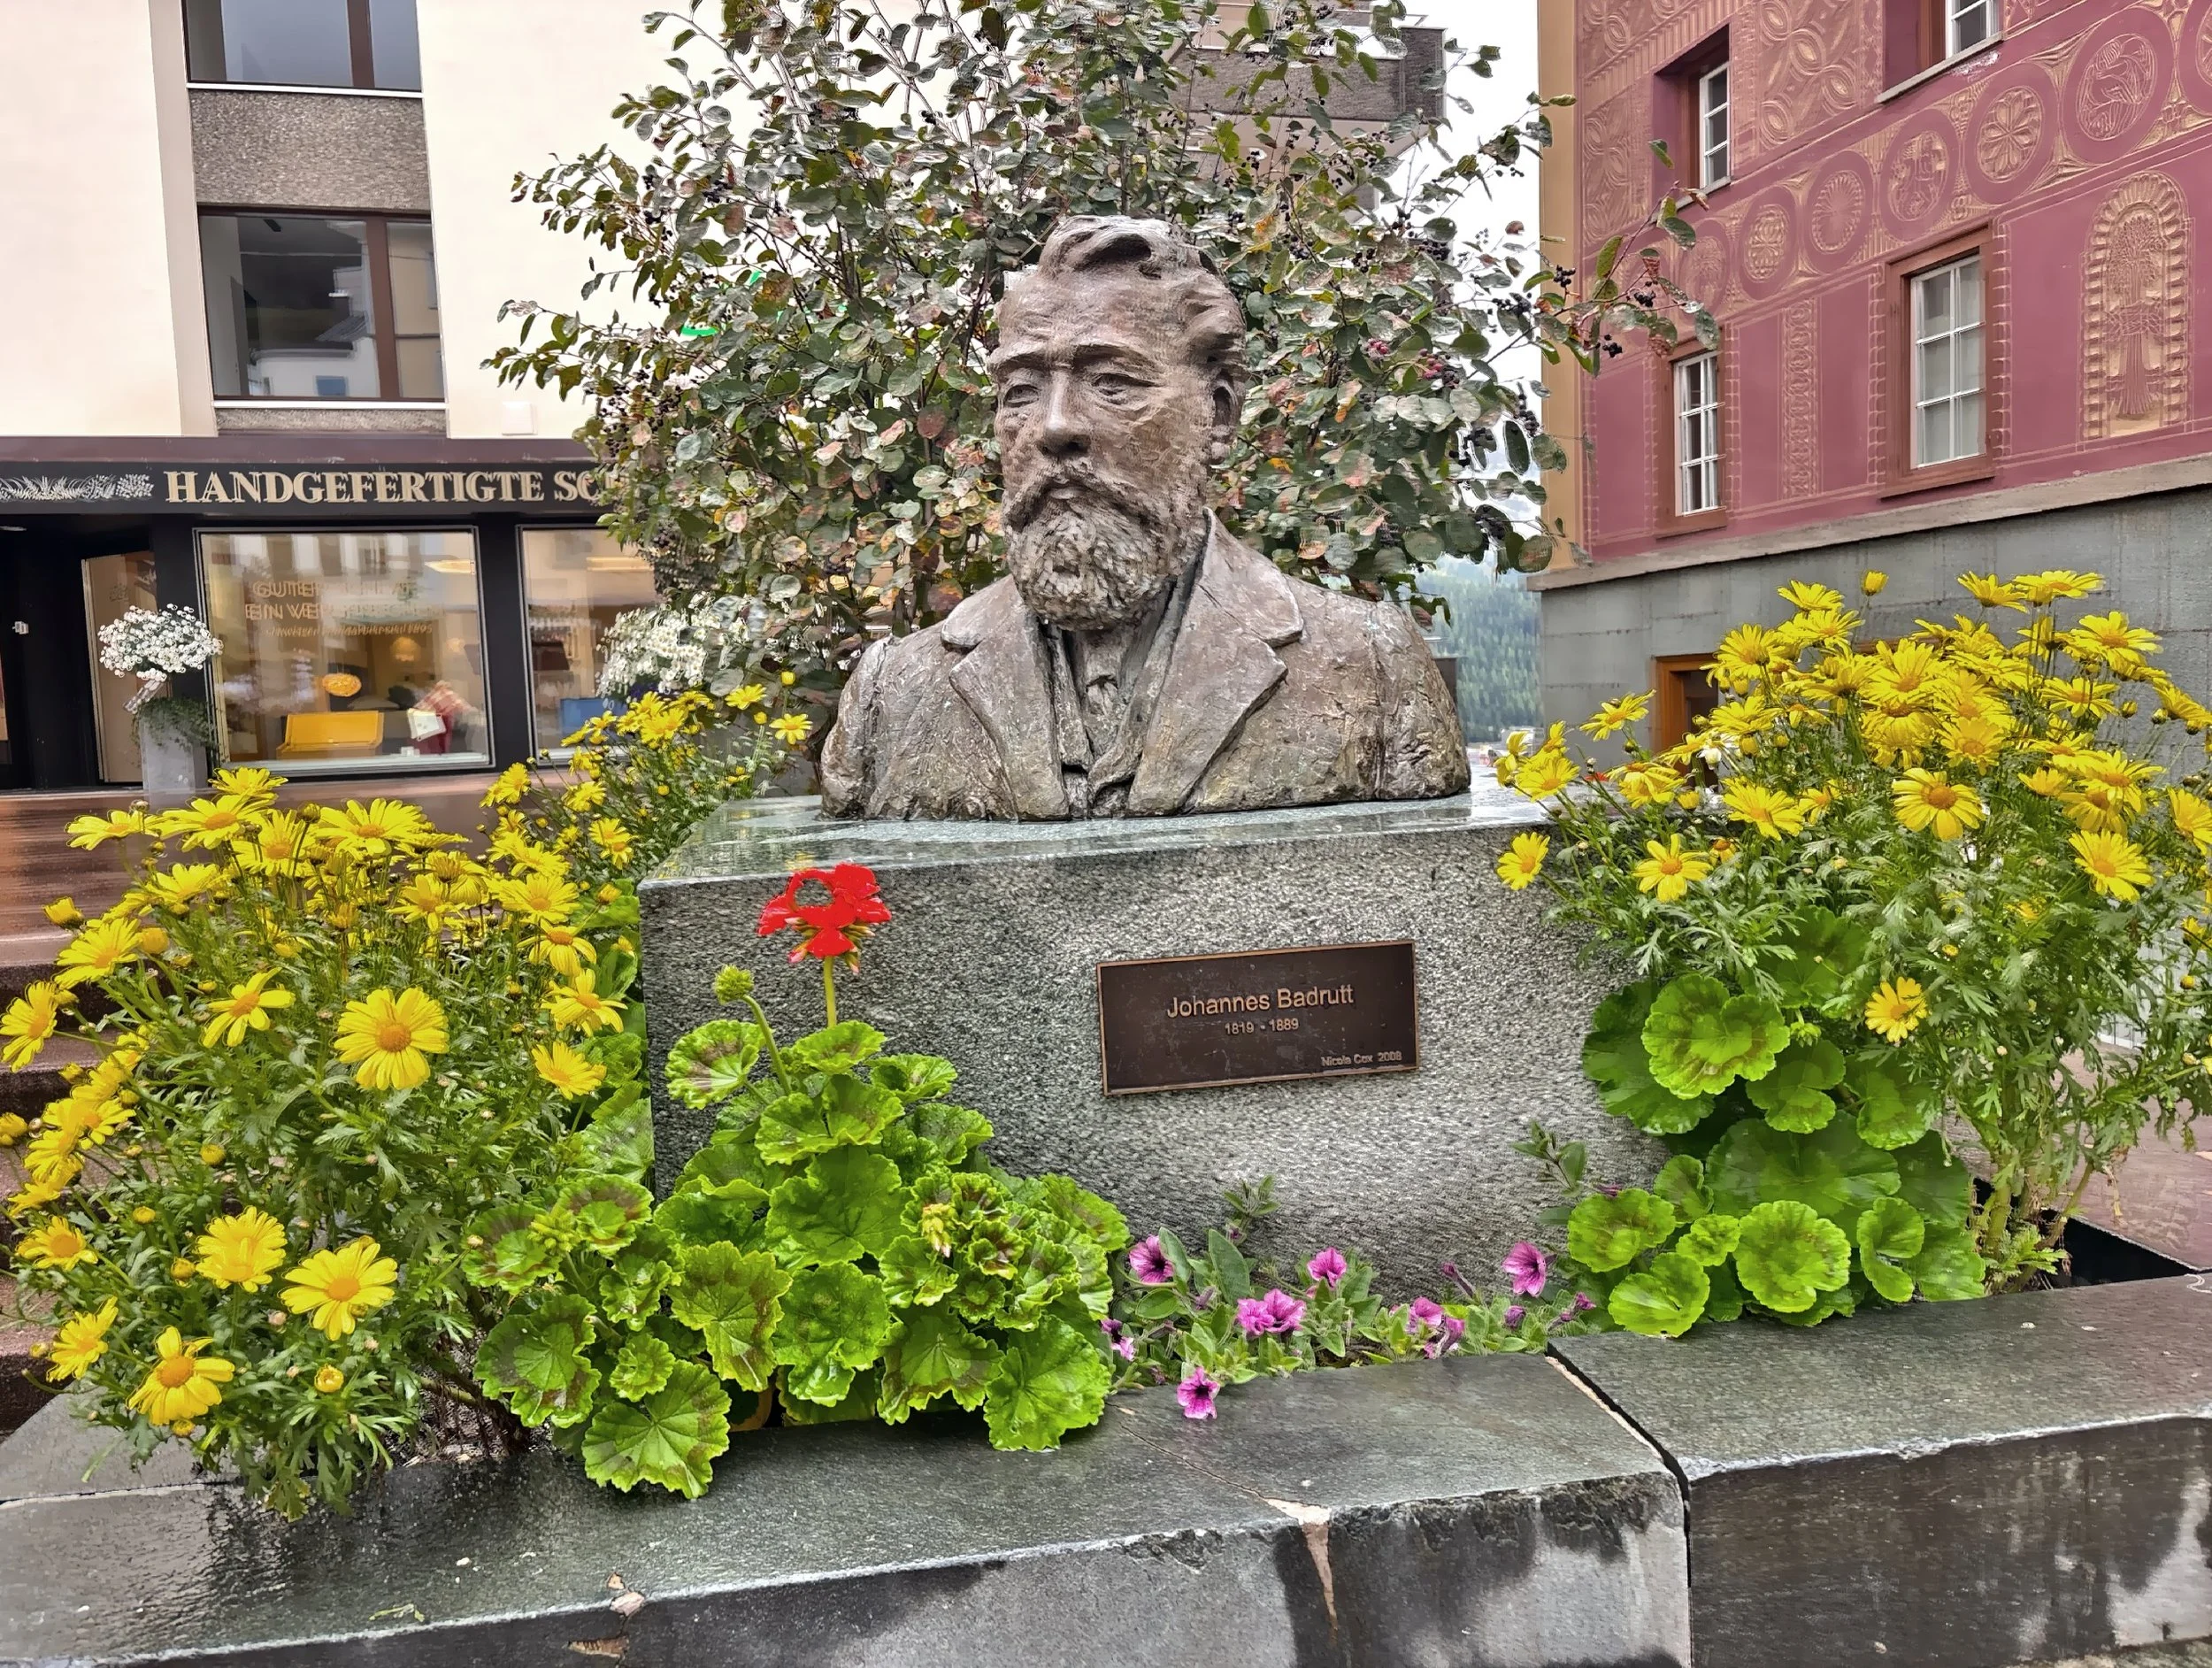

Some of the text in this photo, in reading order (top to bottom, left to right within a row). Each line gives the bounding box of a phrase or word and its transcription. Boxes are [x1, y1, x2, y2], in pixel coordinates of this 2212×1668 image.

[164, 470, 544, 503] HANDGEFERTIGTE
[1166, 983, 1355, 1018] Johannes Badrutt
[1224, 1021, 1255, 1035] 1819
[1270, 1018, 1300, 1032] 1889
[1320, 1050, 1402, 1067] Nicola Cox 2008
